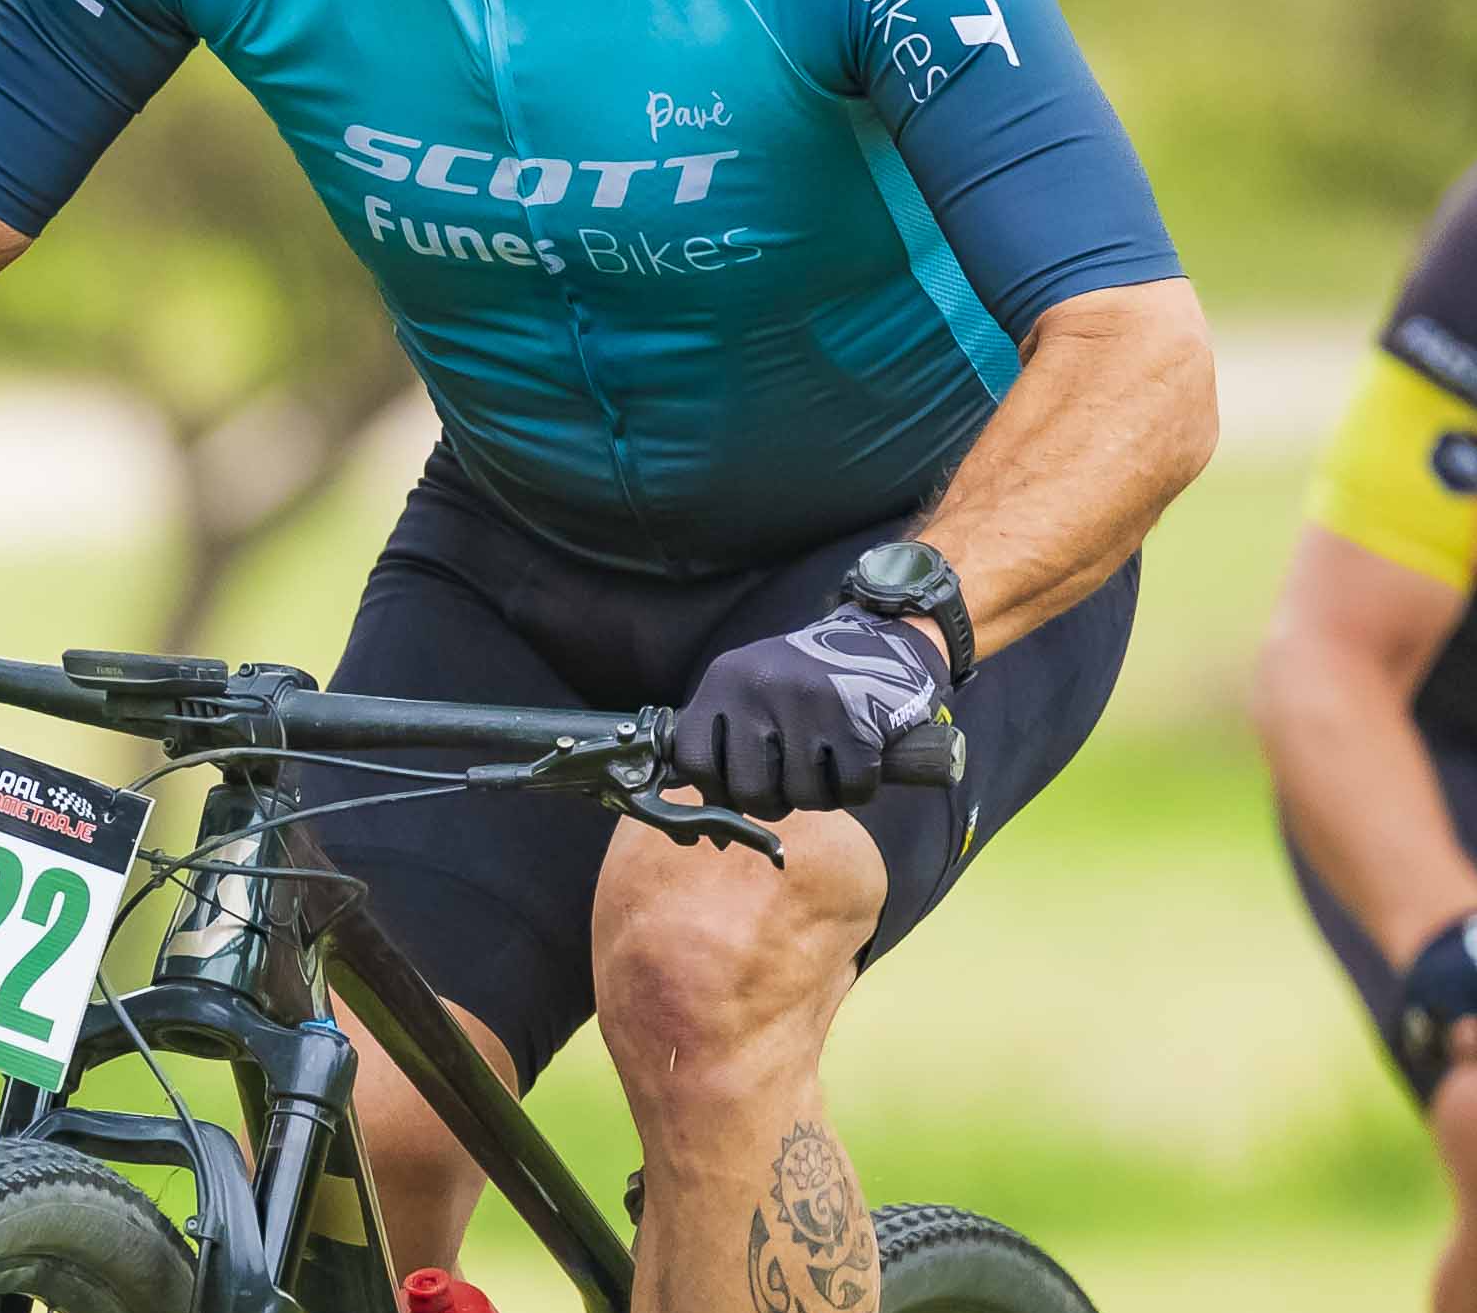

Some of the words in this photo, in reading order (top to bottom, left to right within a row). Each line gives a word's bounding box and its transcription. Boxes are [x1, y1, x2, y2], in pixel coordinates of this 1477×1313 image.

[335, 124, 740, 208] SCOTT
[363, 195, 566, 275] Funes
[578, 226, 763, 276] Bikes
